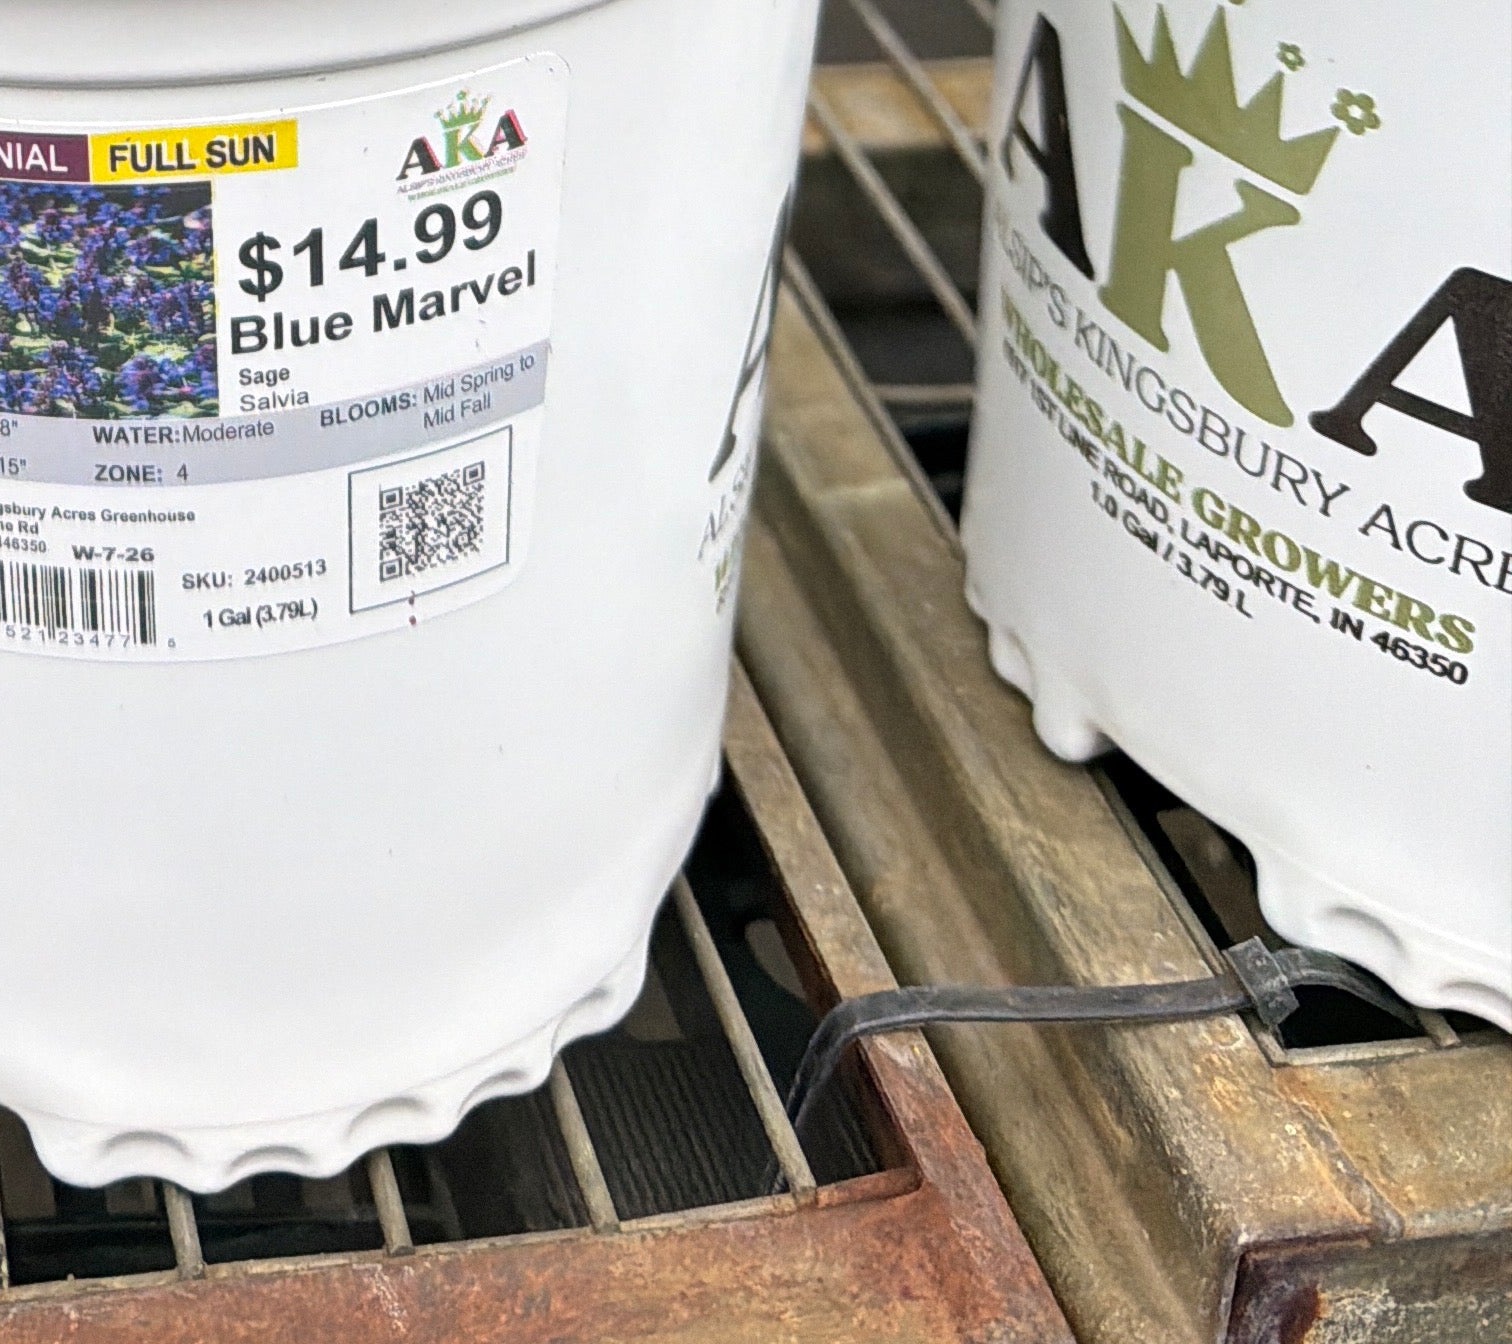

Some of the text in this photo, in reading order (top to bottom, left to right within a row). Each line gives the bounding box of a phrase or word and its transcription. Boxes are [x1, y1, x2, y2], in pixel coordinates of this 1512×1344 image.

[109, 134, 275, 173] FULL SUN
[396, 108, 528, 181] AKA
[238, 190, 502, 302] $14.99
[230, 249, 535, 355] Blue Marvel
[239, 366, 290, 388] Sage
[320, 354, 535, 427] BLOOMS: Mid Spring to
[239, 388, 309, 412] Salvia
[423, 392, 491, 429] Mid Fall
[1074, 307, 1350, 517] KINGSBURY
[92, 419, 275, 444] WATER: Moderate
[94, 464, 189, 483] ZONE: 4
[18, 519, 39, 535] Rd
[51, 506, 96, 521] Acres
[100, 505, 195, 523] Greenhouse
[72, 544, 155, 562] W-7-26
[1057, 412, 1100, 471] LINE
[1103, 455, 1175, 533] ROAD,
[1180, 517, 1321, 624] LAPORTE,
[1327, 607, 1364, 641] IN
[1370, 631, 1469, 685] 46350
[1090, 479, 1120, 521] 1.0
[1122, 513, 1159, 553] Gal
[1176, 551, 1231, 604] 3.79
[1235, 589, 1253, 619] L
[182, 558, 327, 590] SKU: 2400513
[1191, 487, 1476, 655] GROWERS
[203, 597, 318, 629] 1 Gal (3.79L)
[58, 631, 130, 647] 23477
